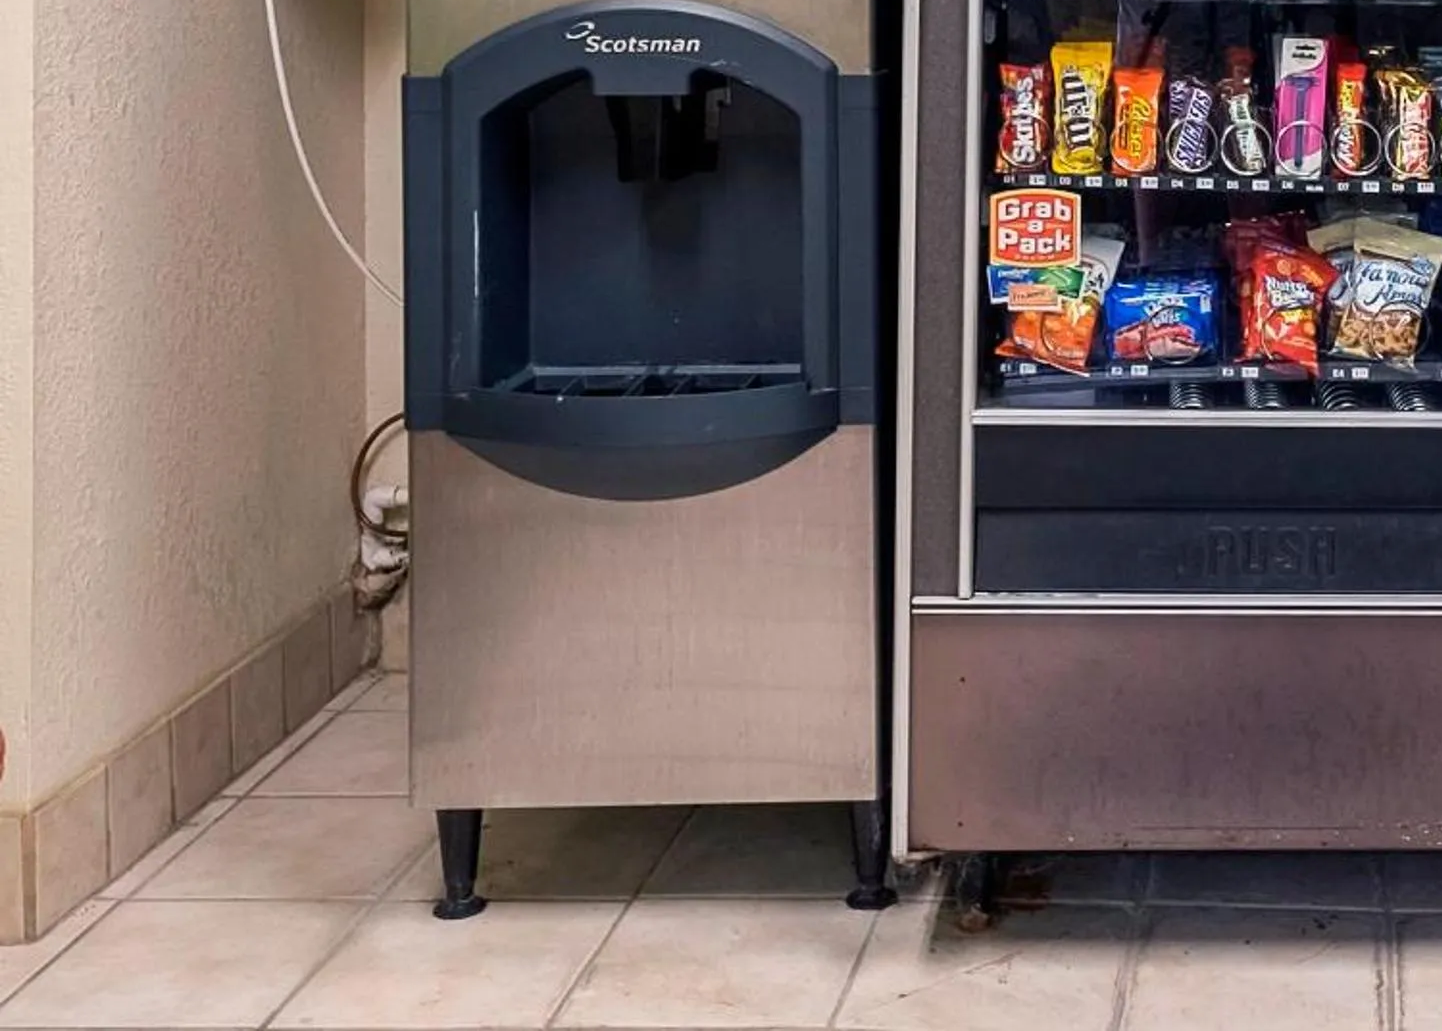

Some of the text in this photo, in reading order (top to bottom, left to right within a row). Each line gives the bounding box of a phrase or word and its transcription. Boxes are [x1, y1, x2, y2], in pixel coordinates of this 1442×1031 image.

[584, 35, 701, 54] Scotsman
[1011, 76, 1036, 163] Skittles
[1173, 87, 1213, 168] SNICKERS
[997, 198, 1072, 221] Grab
[1027, 220, 1044, 234] a
[997, 228, 1072, 255] Pack
[1359, 260, 1429, 288] Famous
[1206, 526, 1337, 578] PUSH
